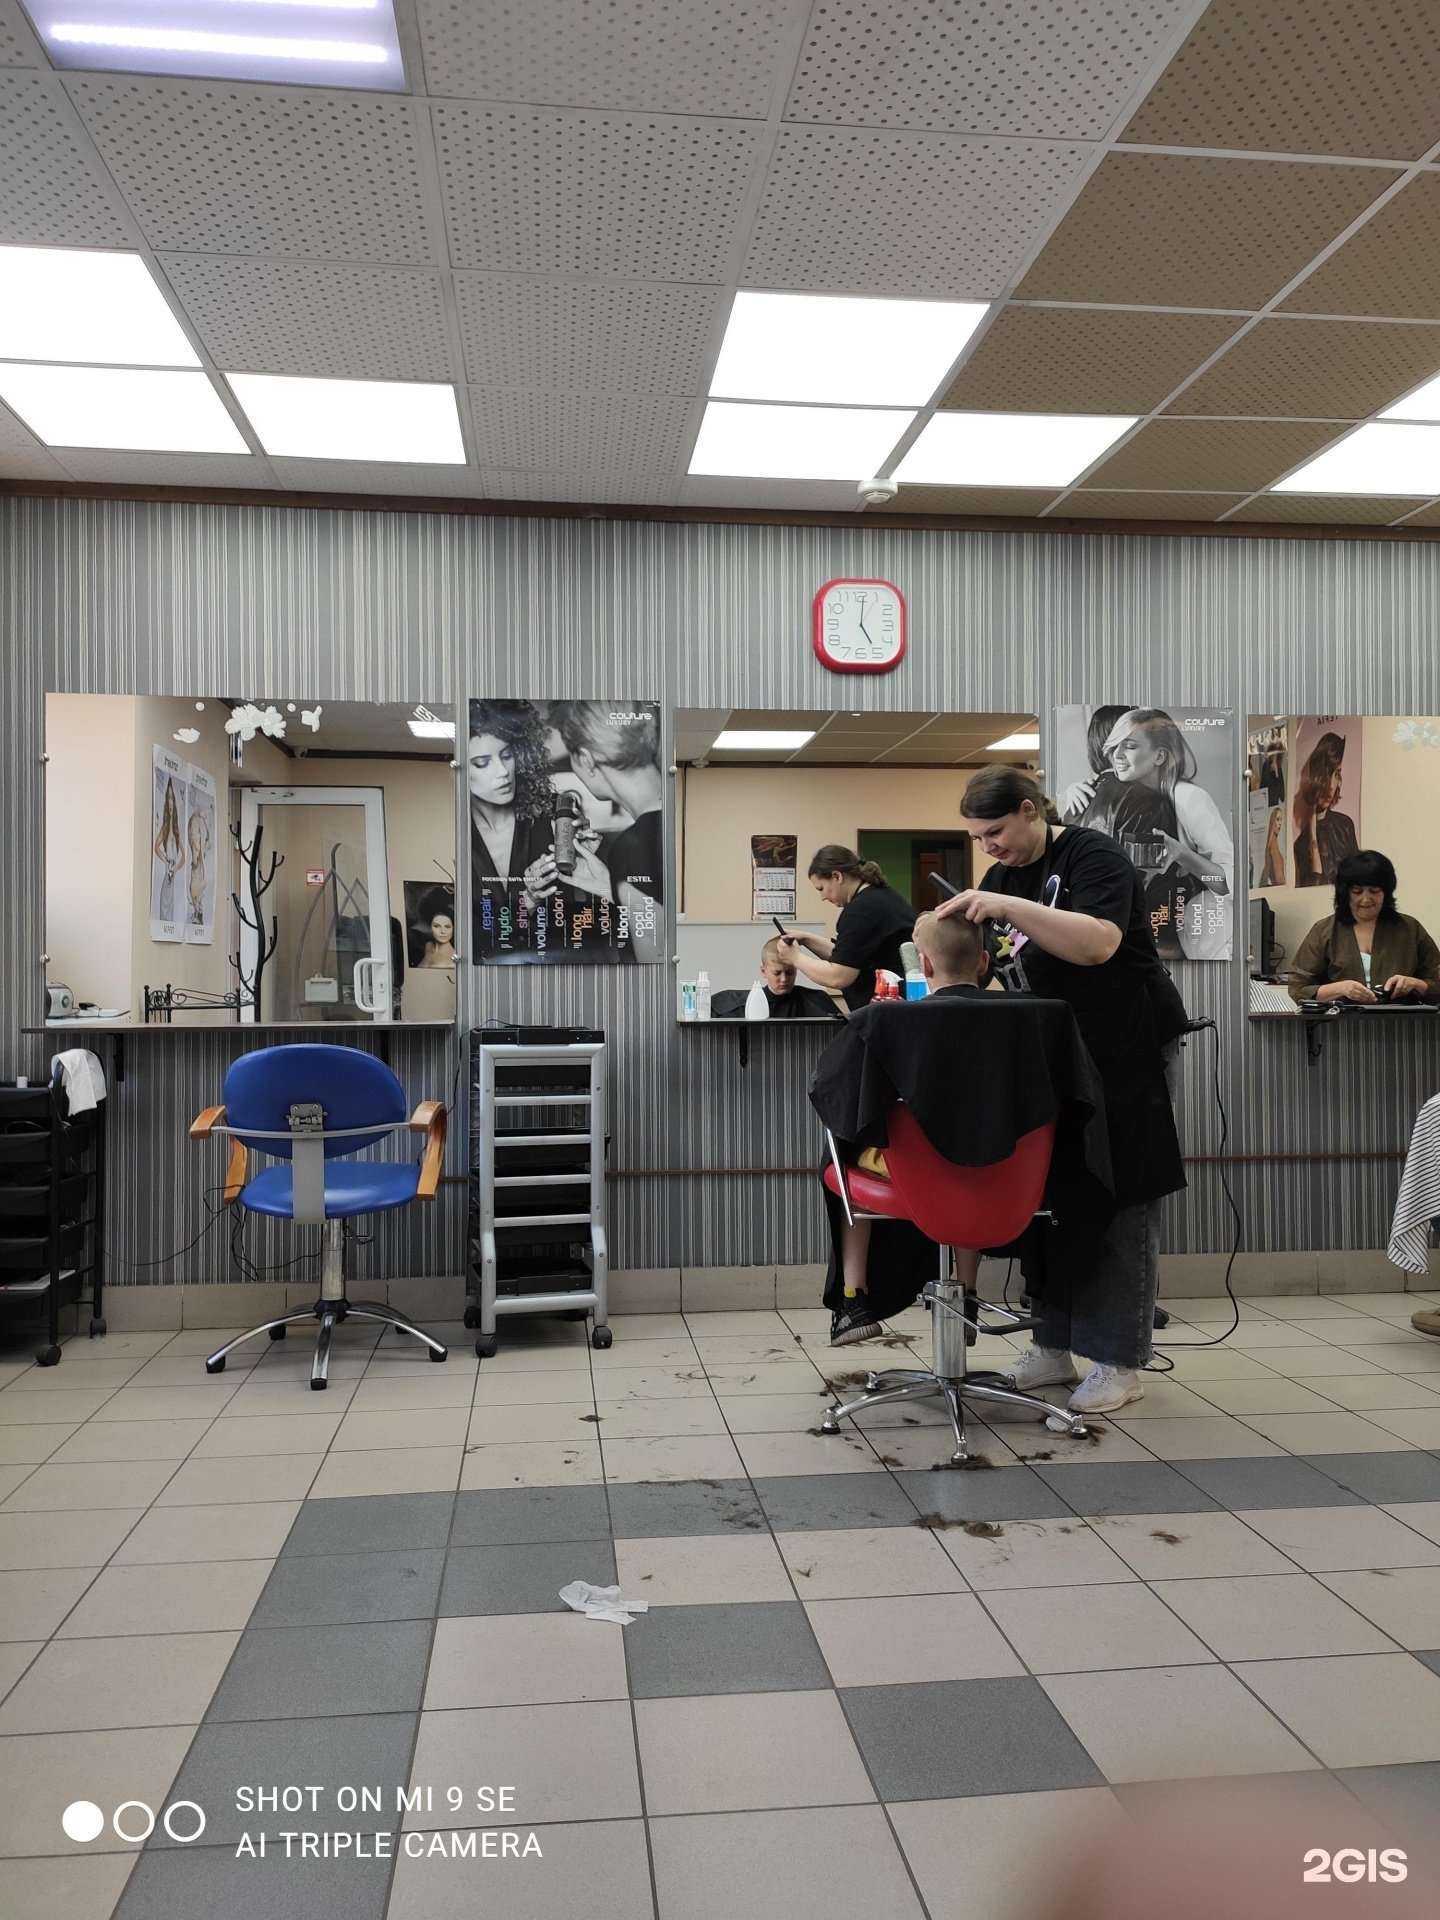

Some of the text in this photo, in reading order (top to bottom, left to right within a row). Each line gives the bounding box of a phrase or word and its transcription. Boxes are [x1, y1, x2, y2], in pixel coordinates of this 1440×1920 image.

[841, 646, 884, 659] 7 6 5
[480, 897, 494, 930] repair
[498, 906, 512, 940] hydro
[516, 898, 528, 928] shine
[553, 897, 564, 927] color
[571, 914, 583, 940] long
[581, 907, 593, 928] hair
[599, 897, 610, 935] volute
[617, 906, 629, 938] blond
[633, 912, 644, 937] cool
[642, 897, 654, 929] blond
[1158, 904, 1169, 925] hair
[1174, 896, 1185, 932] volute
[1192, 904, 1202, 935] blond
[1206, 910, 1216, 934] cool
[1214, 896, 1224, 927] blond
[535, 906, 546, 949] volume
